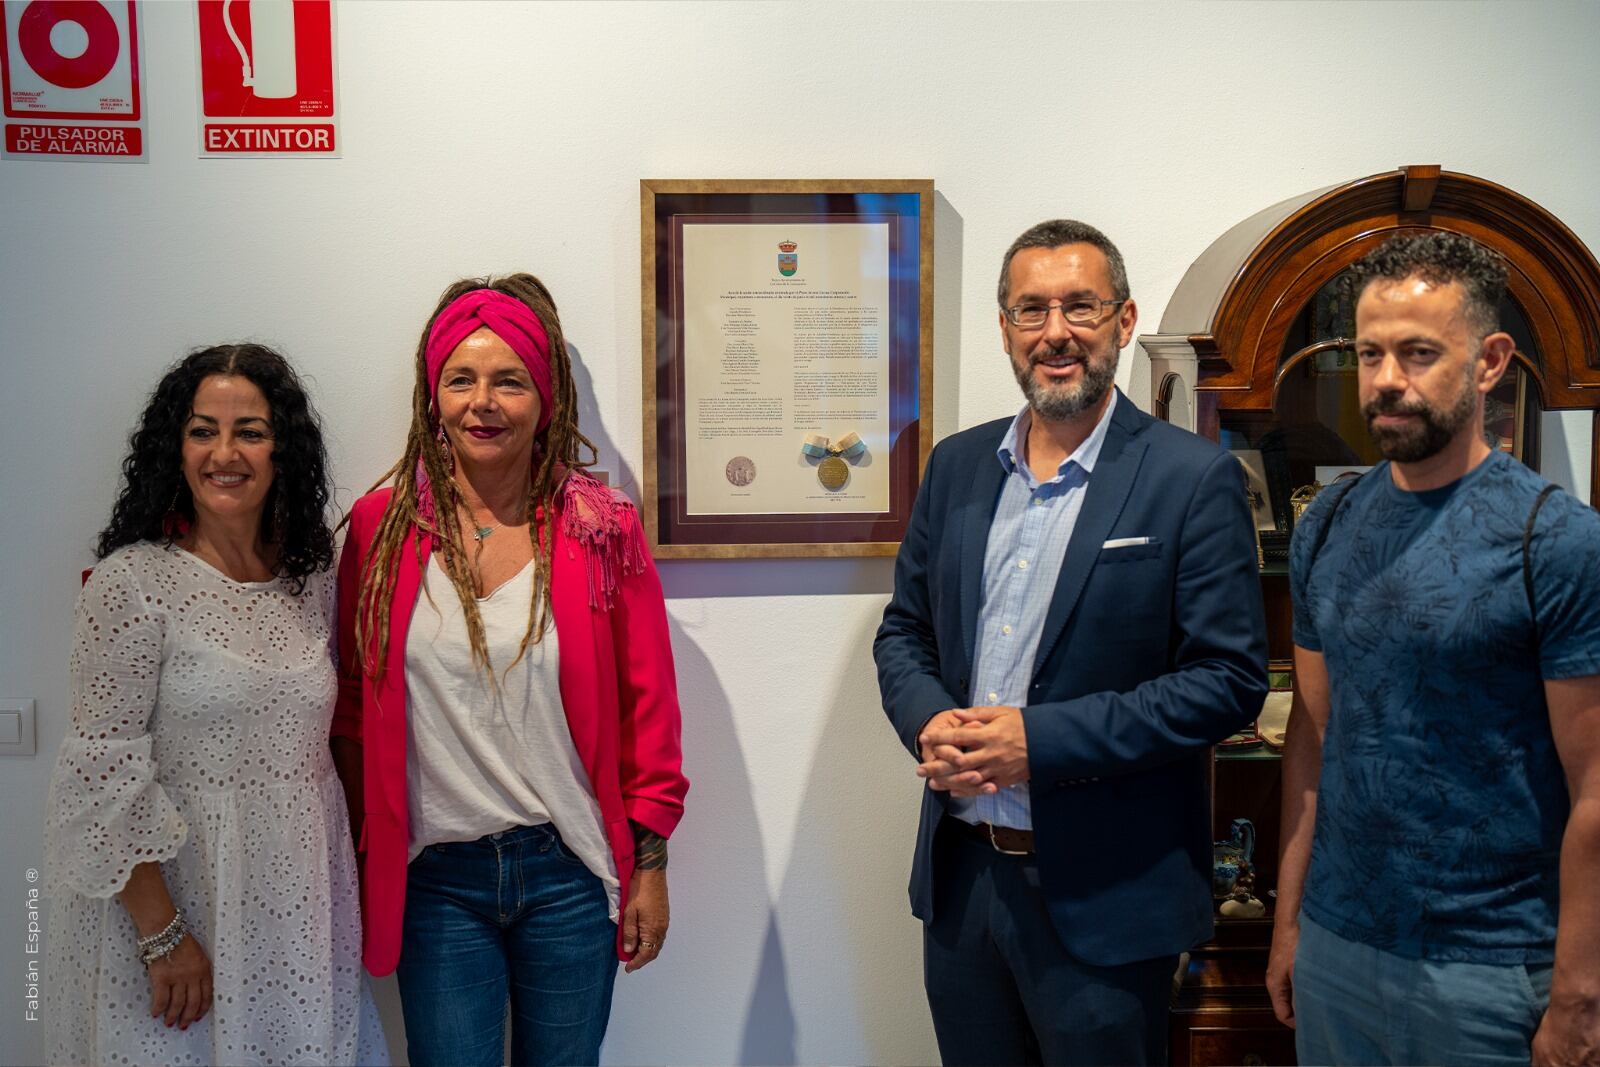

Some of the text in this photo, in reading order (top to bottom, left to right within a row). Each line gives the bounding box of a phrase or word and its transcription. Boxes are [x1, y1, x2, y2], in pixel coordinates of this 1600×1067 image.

[20, 127, 125, 141] PULSADOR
[208, 128, 330, 149] EXTINTOR
[16, 139, 129, 154] DE ALARMA
